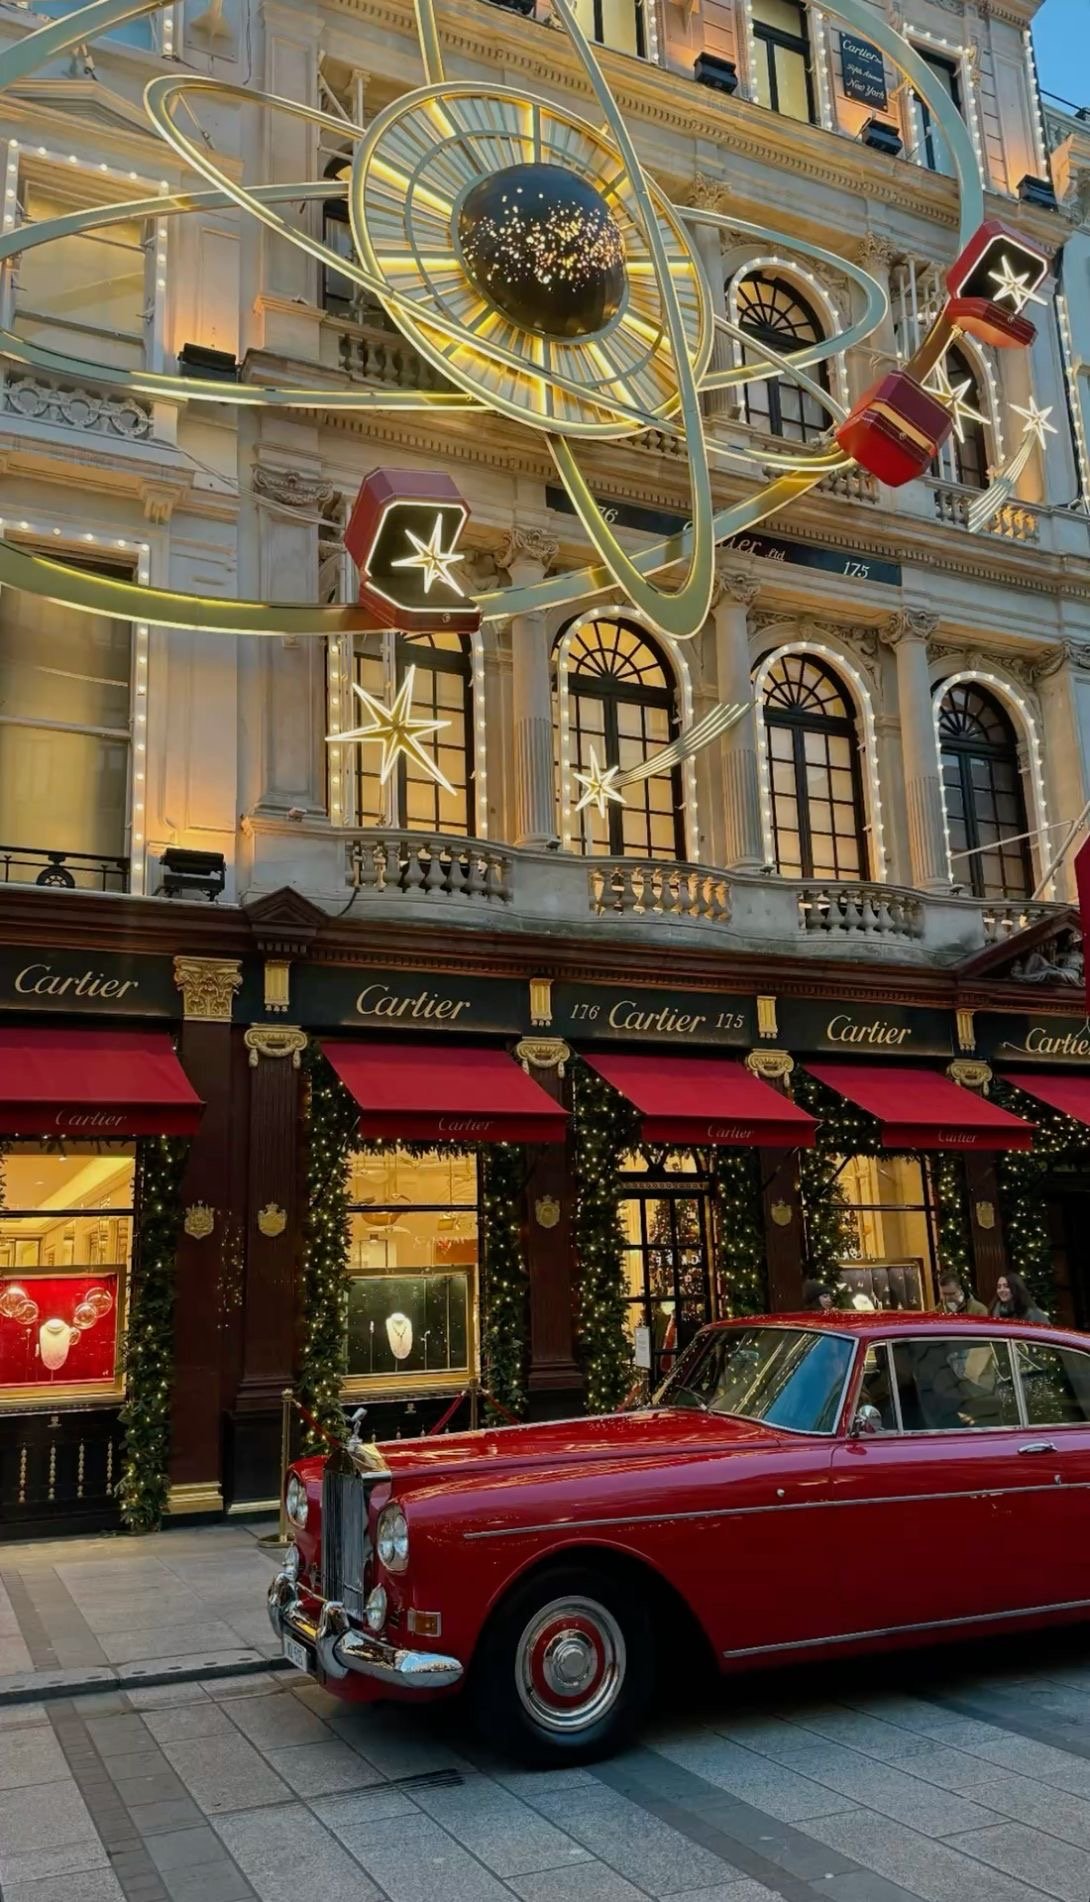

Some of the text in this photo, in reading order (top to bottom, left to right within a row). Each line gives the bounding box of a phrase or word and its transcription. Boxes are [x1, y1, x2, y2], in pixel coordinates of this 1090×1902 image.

[843, 40, 877, 60] Cartier
[846, 79, 884, 99] New York
[843, 561, 870, 579] 175
[15, 964, 139, 998] Cartier
[356, 984, 471, 1019] Cartier
[570, 1000, 745, 1032] 176 Cartier 175
[827, 1014, 912, 1044] Cartier
[1002, 1027, 1090, 1055] Cartie
[55, 1109, 127, 1127] Cartier
[438, 1117, 494, 1131] Cartier
[707, 1125, 755, 1139] Cartier
